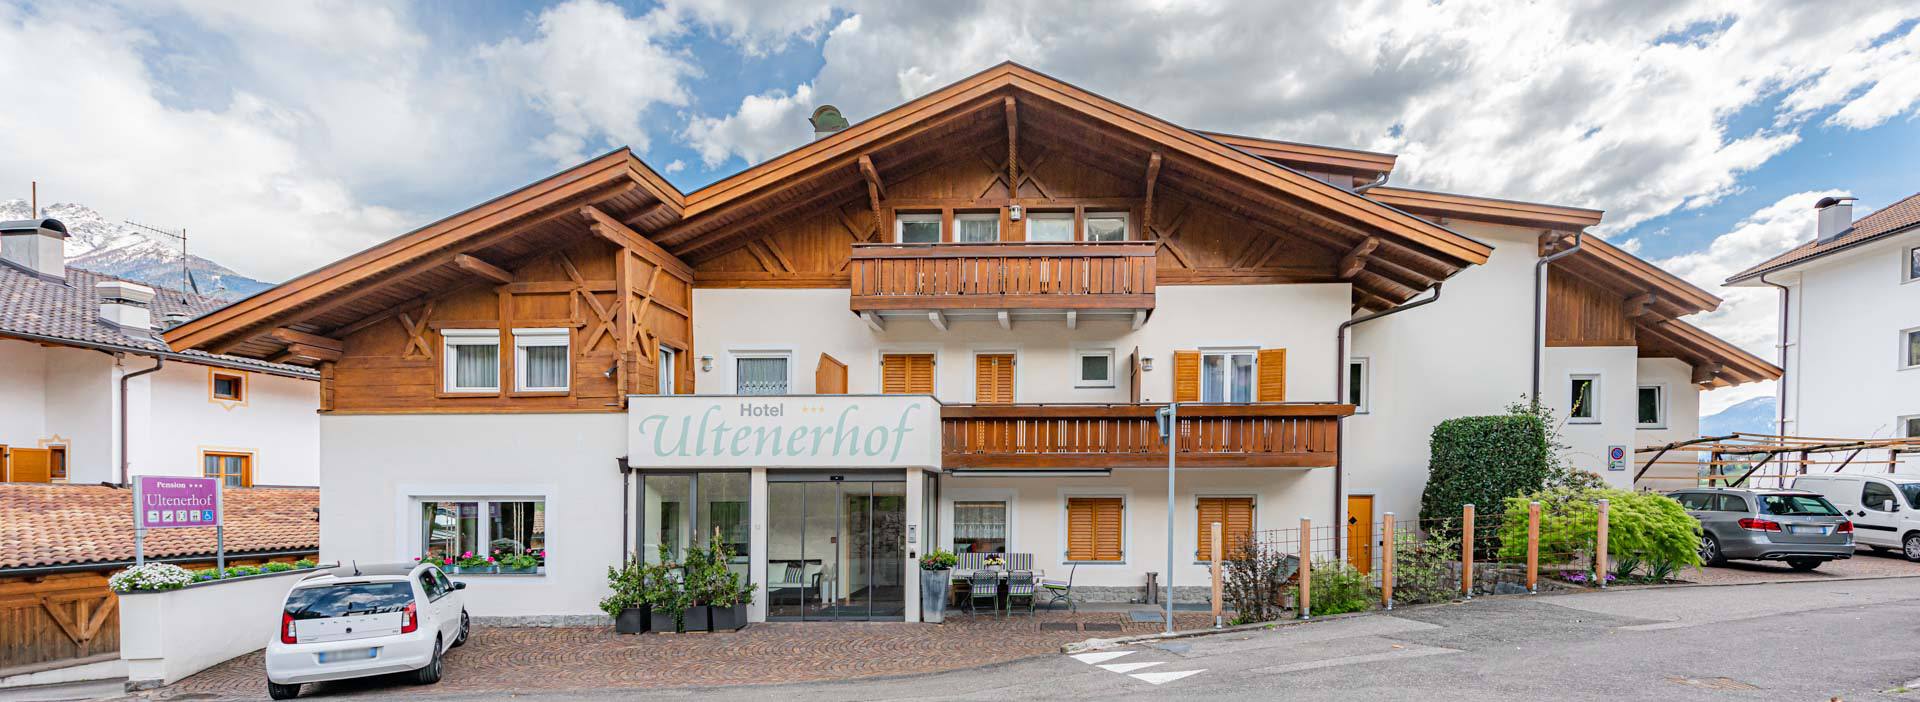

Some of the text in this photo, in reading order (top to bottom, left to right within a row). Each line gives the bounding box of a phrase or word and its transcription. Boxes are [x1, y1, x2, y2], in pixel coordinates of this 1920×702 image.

[740, 403, 784, 417] Hotel
[638, 403, 921, 463] Ultenerhof
[156, 481, 186, 489] Pension
[146, 493, 213, 506] Ultenerhof
